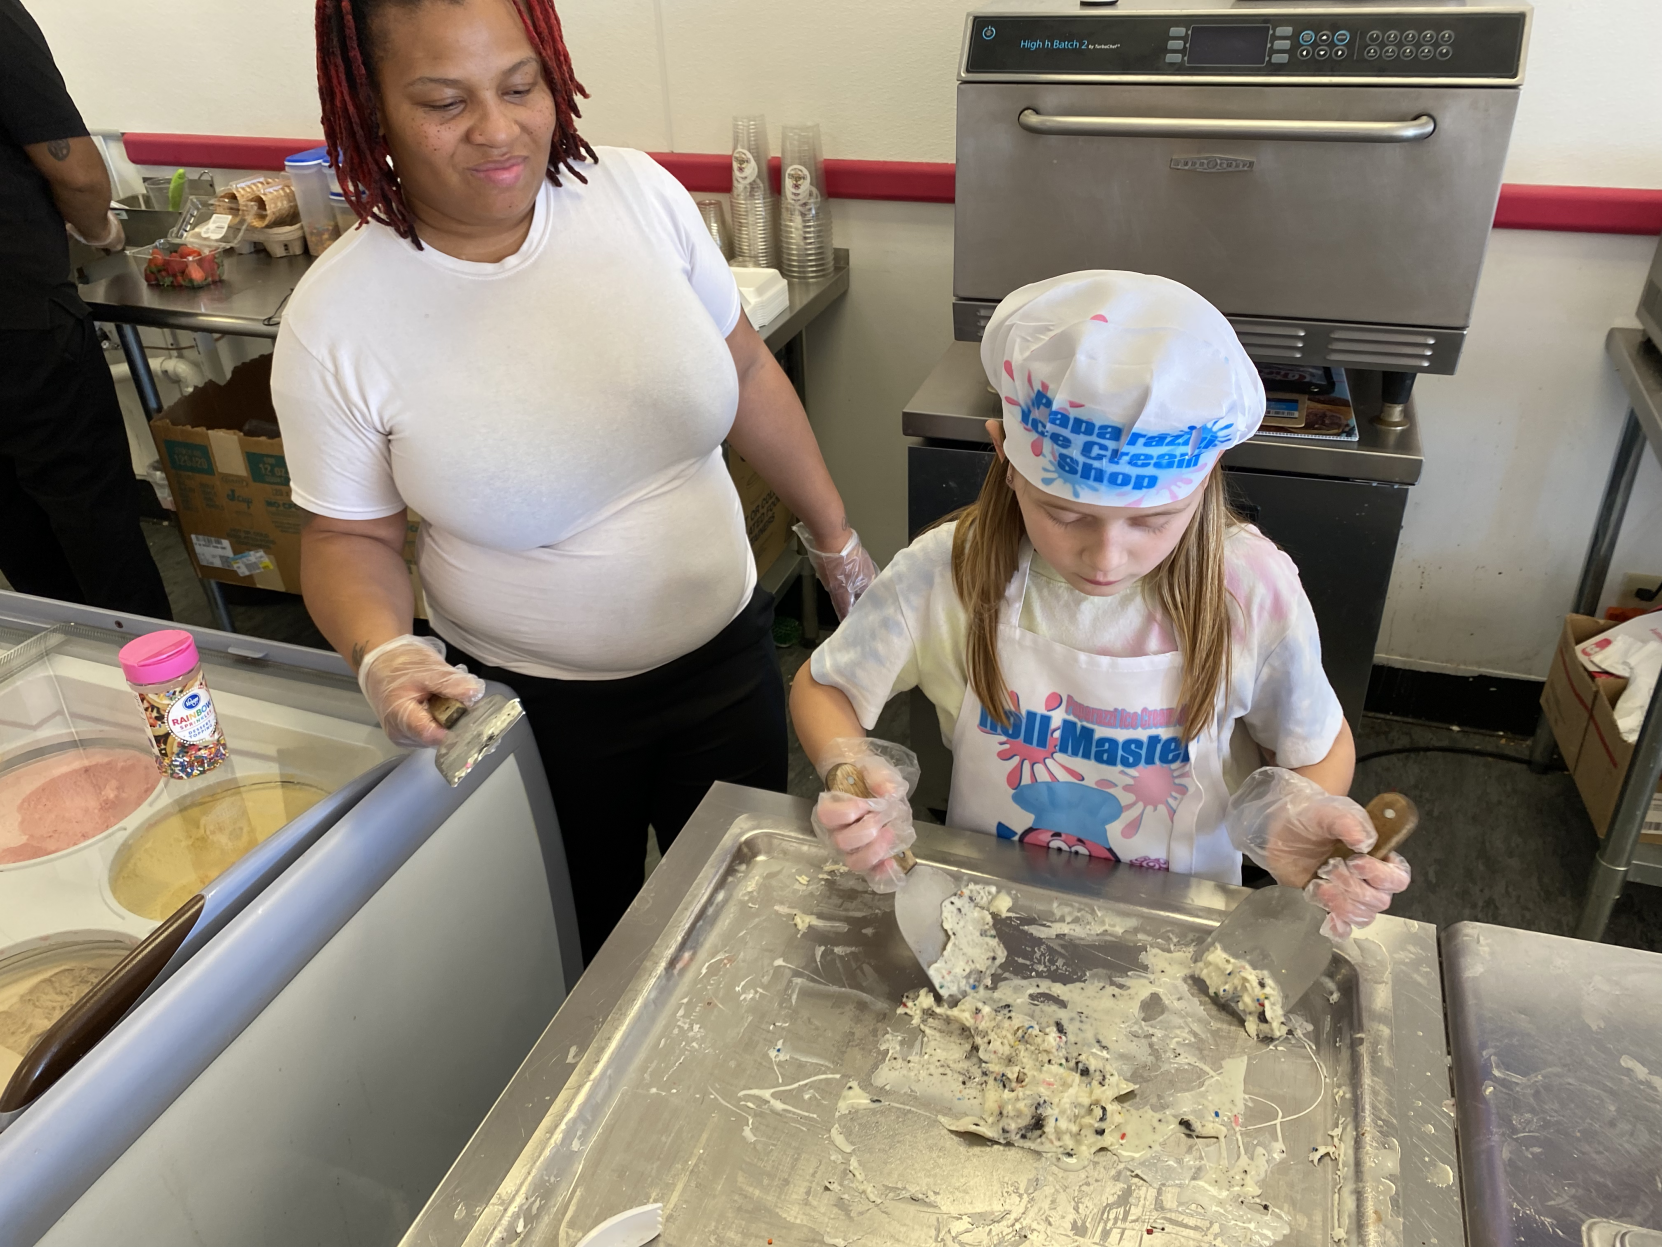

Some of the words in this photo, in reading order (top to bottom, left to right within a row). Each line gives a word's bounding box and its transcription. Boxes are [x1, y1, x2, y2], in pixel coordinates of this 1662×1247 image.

[1020, 39, 1042, 51] High
[1053, 39, 1079, 49] Batch
[1081, 40, 1088, 49] 2
[1057, 452, 1158, 490] Shop
[171, 699, 211, 727] RAINBOW
[1119, 708, 1139, 730] Ice
